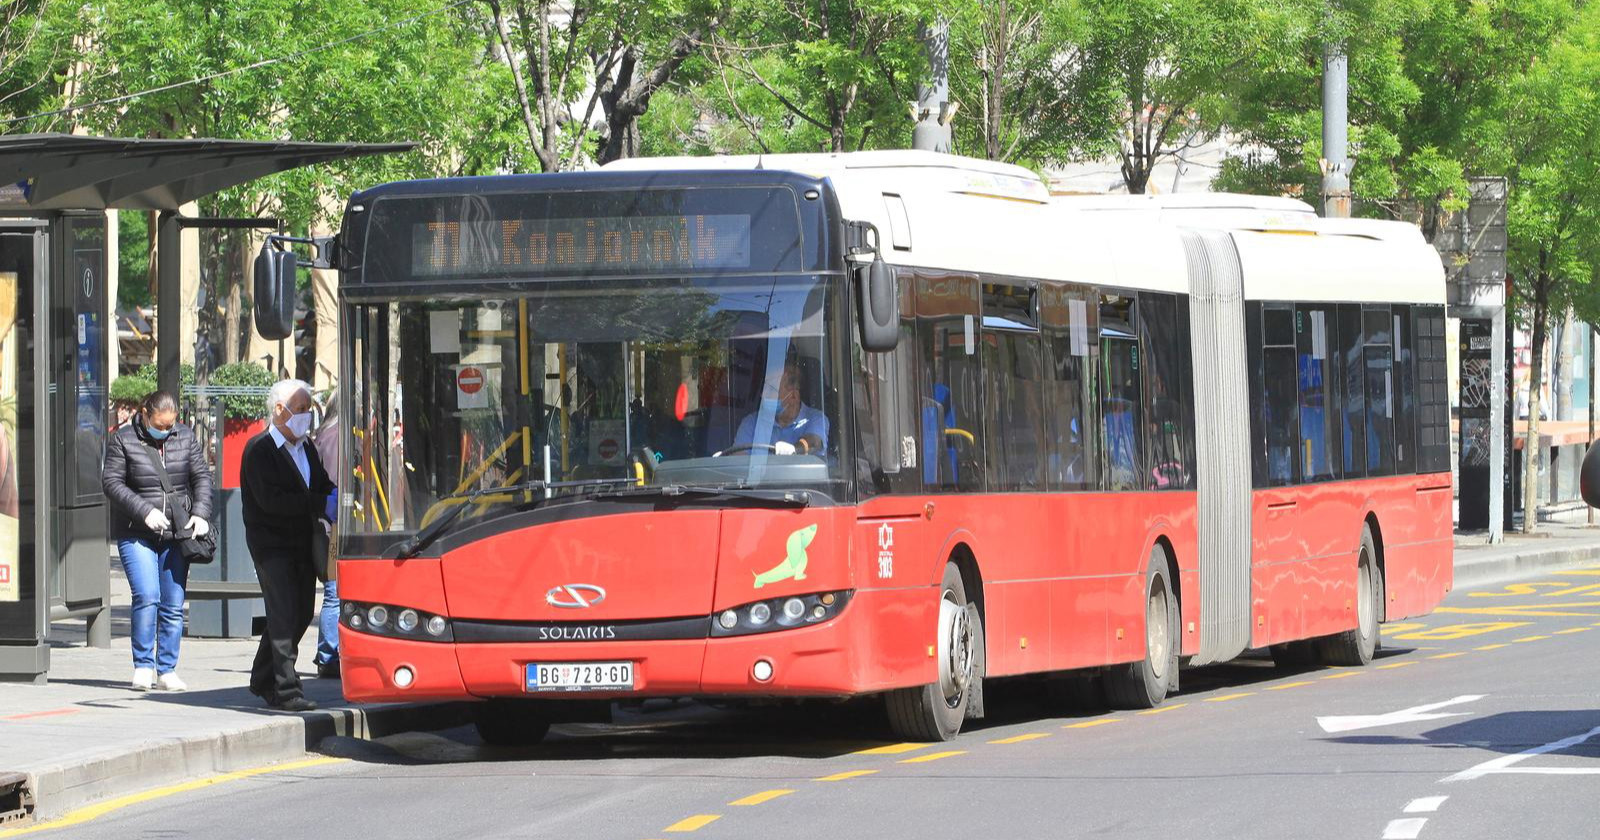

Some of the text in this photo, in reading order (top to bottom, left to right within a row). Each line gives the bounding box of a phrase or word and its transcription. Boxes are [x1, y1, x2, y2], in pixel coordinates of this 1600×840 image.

[502, 215, 716, 265] Konjarnik
[539, 625, 616, 640] SOLARIS
[540, 667, 560, 684] BG
